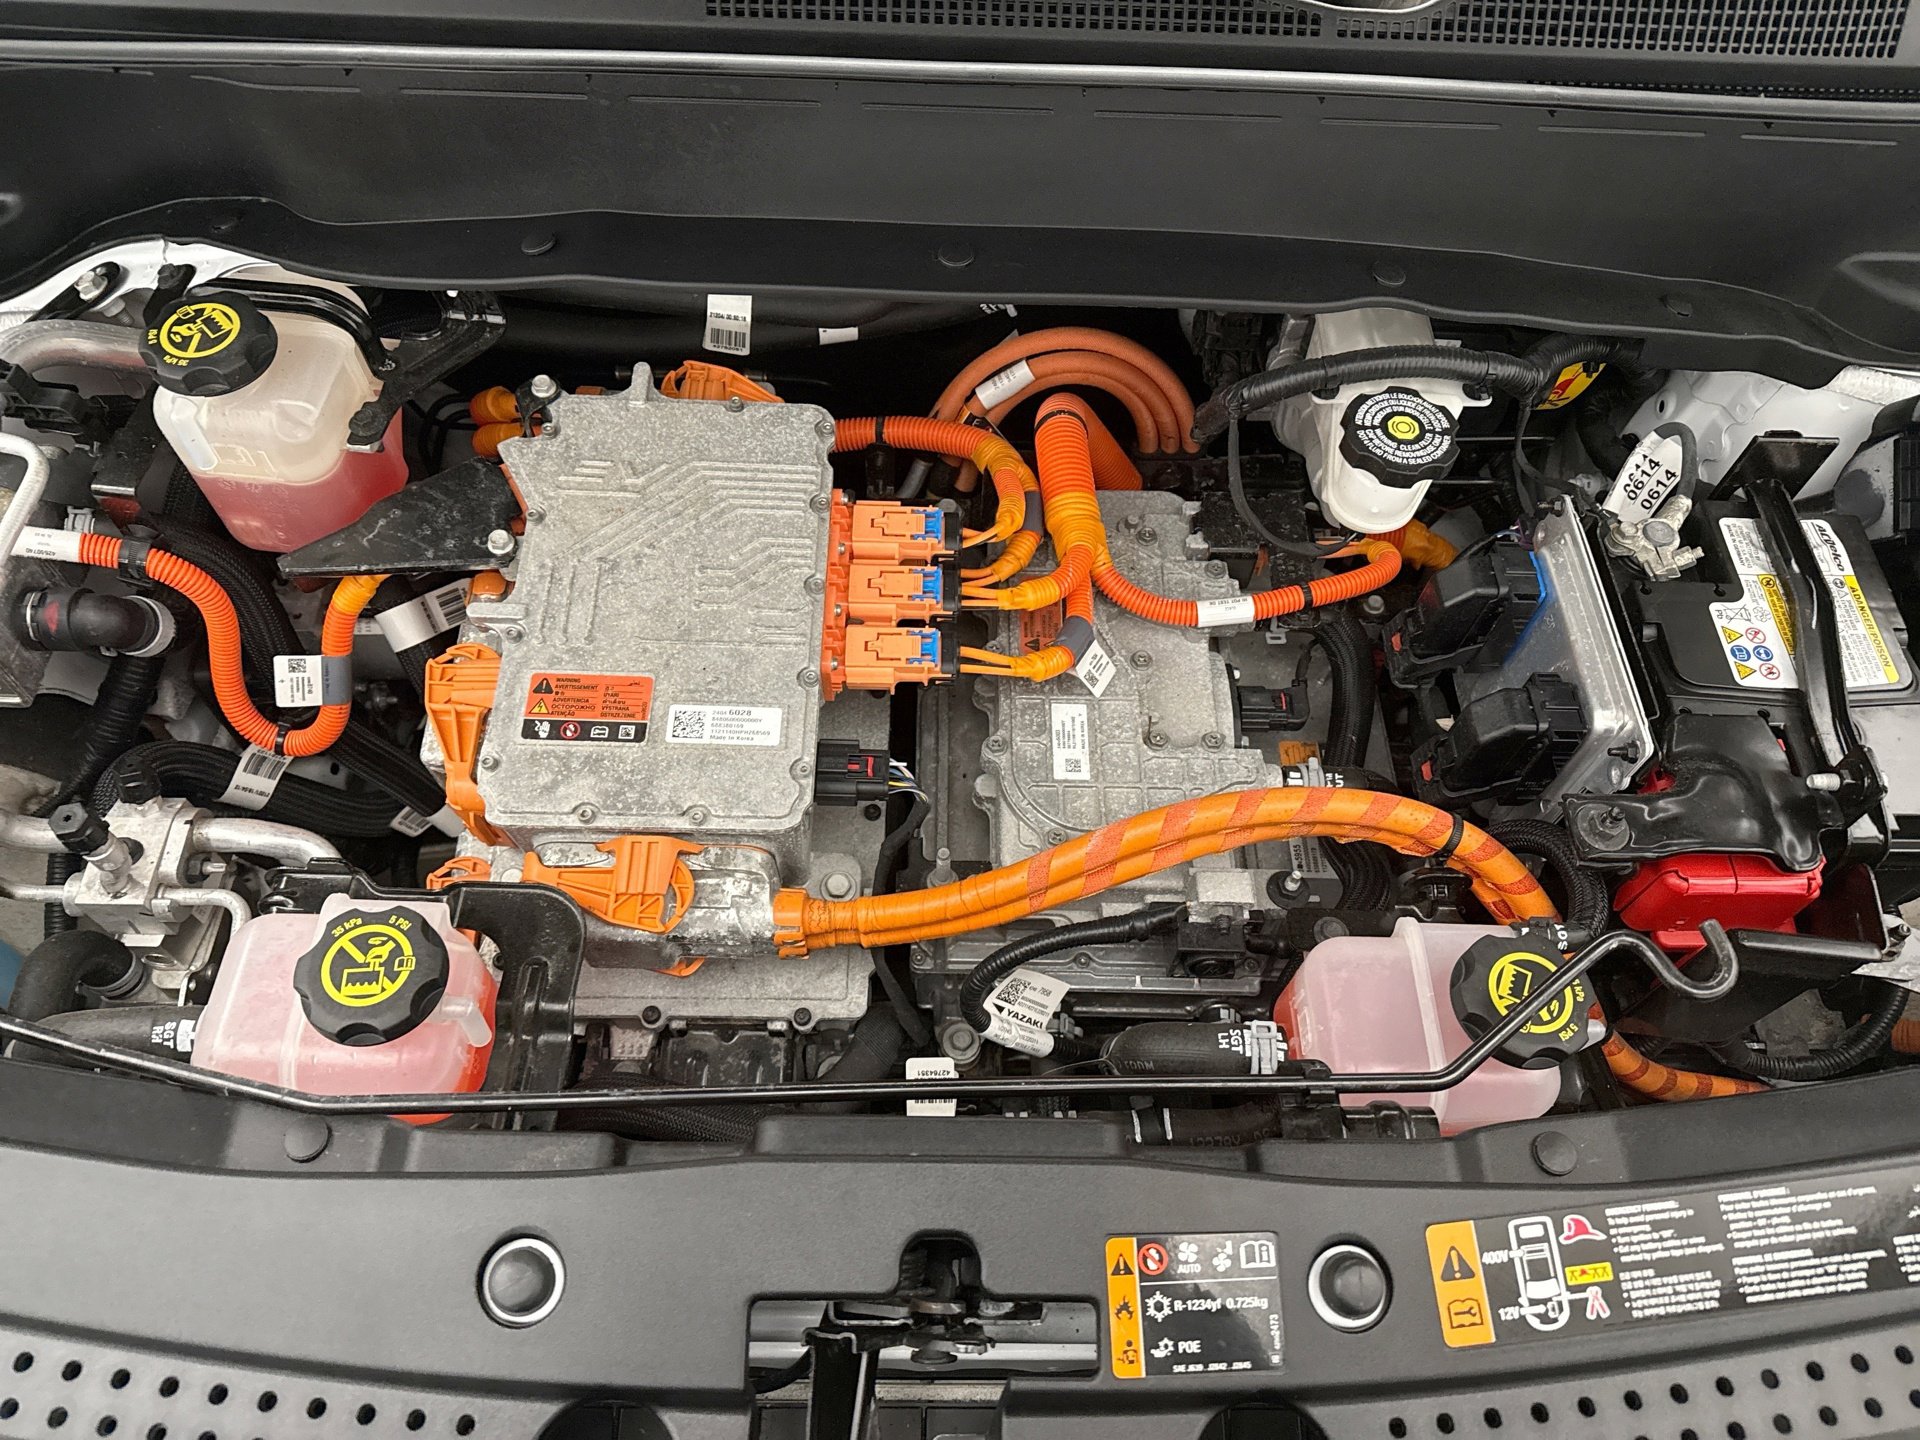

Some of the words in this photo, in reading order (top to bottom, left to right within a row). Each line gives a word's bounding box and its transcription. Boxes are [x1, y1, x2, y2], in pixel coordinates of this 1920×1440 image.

[1627, 458, 1660, 501] 0614
[1640, 469, 1677, 510] 0614
[1815, 523, 1845, 572] ACDelco
[728, 709, 752, 717] 6028
[331, 928, 345, 938] 35
[343, 917, 363, 931] kPa
[388, 914, 398, 925] 5
[395, 917, 413, 932] PSI
[1574, 985, 1585, 1003] kPa
[1006, 1008, 1044, 1030] YAZAKI
[1569, 1022, 1579, 1033] 5
[163, 1021, 178, 1050] SGT
[1217, 1032, 1230, 1049] LH
[1229, 1028, 1244, 1055] SGT
[1558, 1027, 1574, 1042] PSI
[1482, 1251, 1509, 1265] 400V
[1177, 1263, 1201, 1274] AUTO
[1174, 1299, 1222, 1312] R-1234yf
[1226, 1297, 1269, 1310] 0.725kg
[1498, 1306, 1520, 1321] 12V
[1178, 1341, 1201, 1354] POE
[1172, 1364, 1186, 1373] SAE
